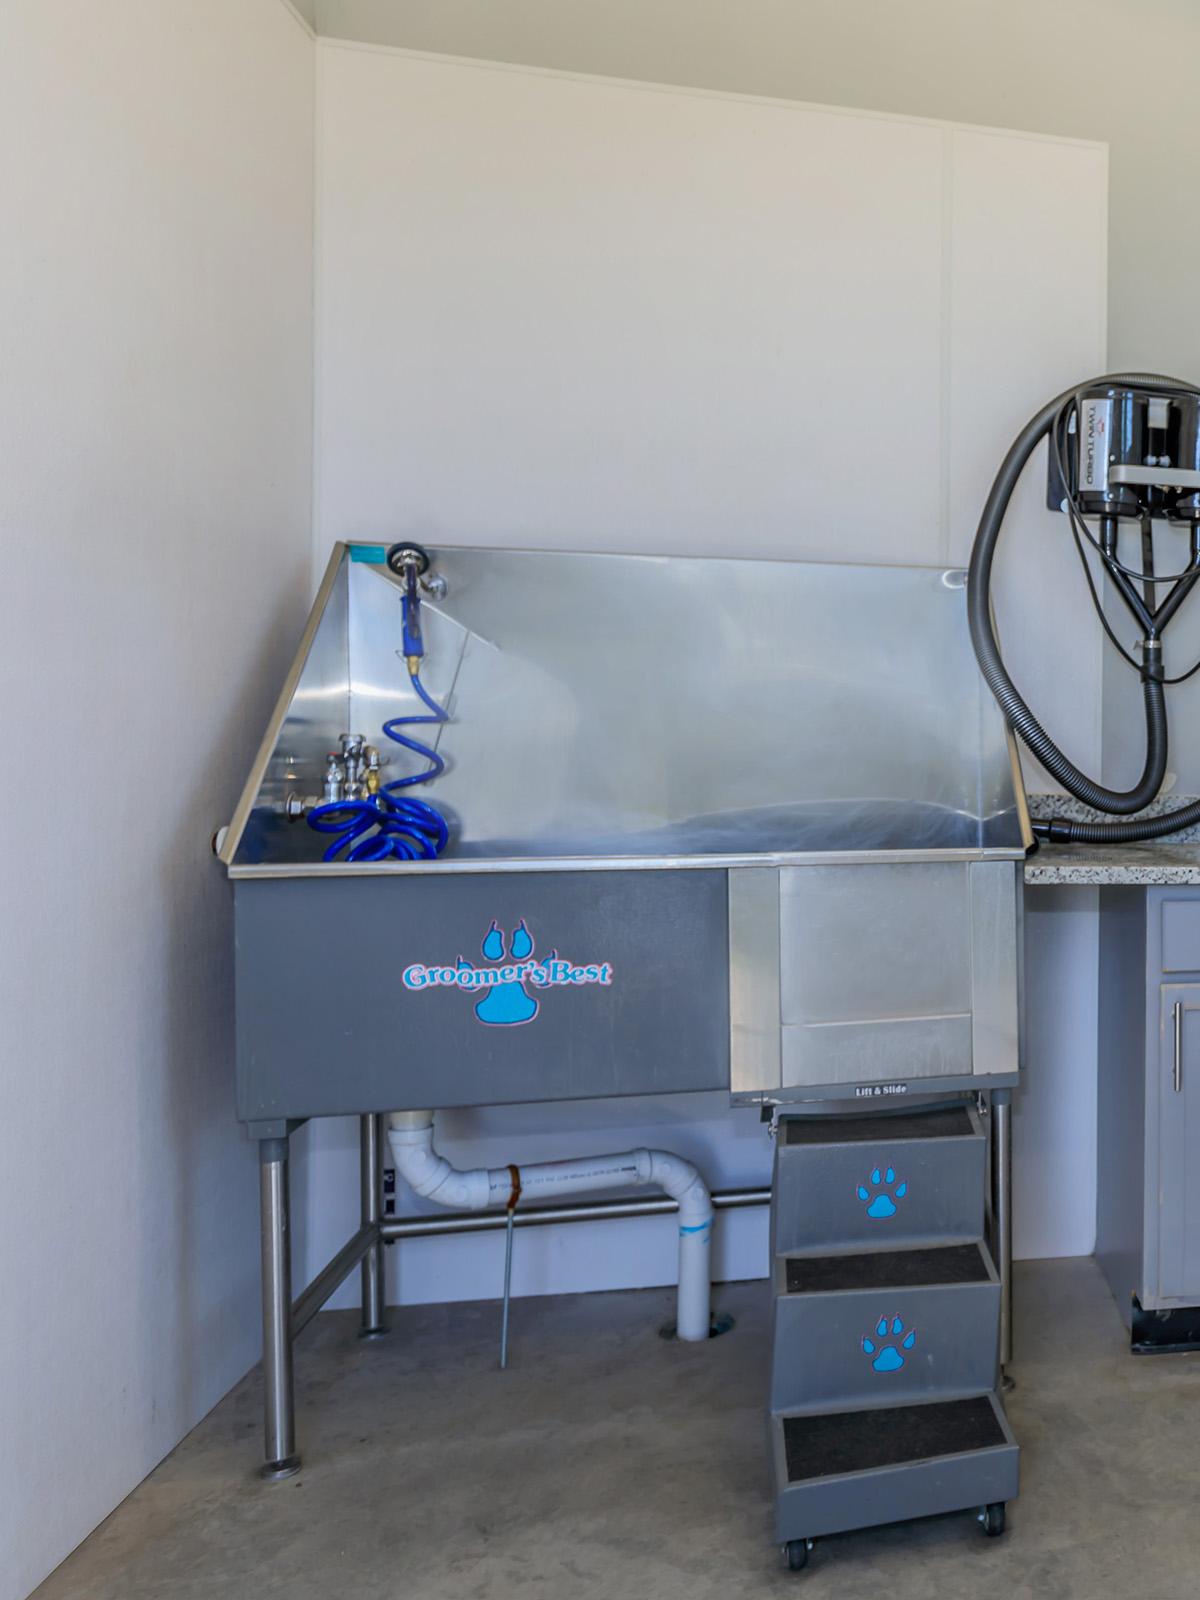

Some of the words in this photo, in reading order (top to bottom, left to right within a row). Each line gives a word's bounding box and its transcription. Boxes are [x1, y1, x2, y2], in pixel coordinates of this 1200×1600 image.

[1088, 406, 1096, 438] TWIN
[402, 961, 546, 990] Groomer's
[550, 960, 613, 985] Best
[856, 1087, 872, 1097] Lift
[874, 1086, 881, 1095] &
[883, 1084, 906, 1095] Slide
